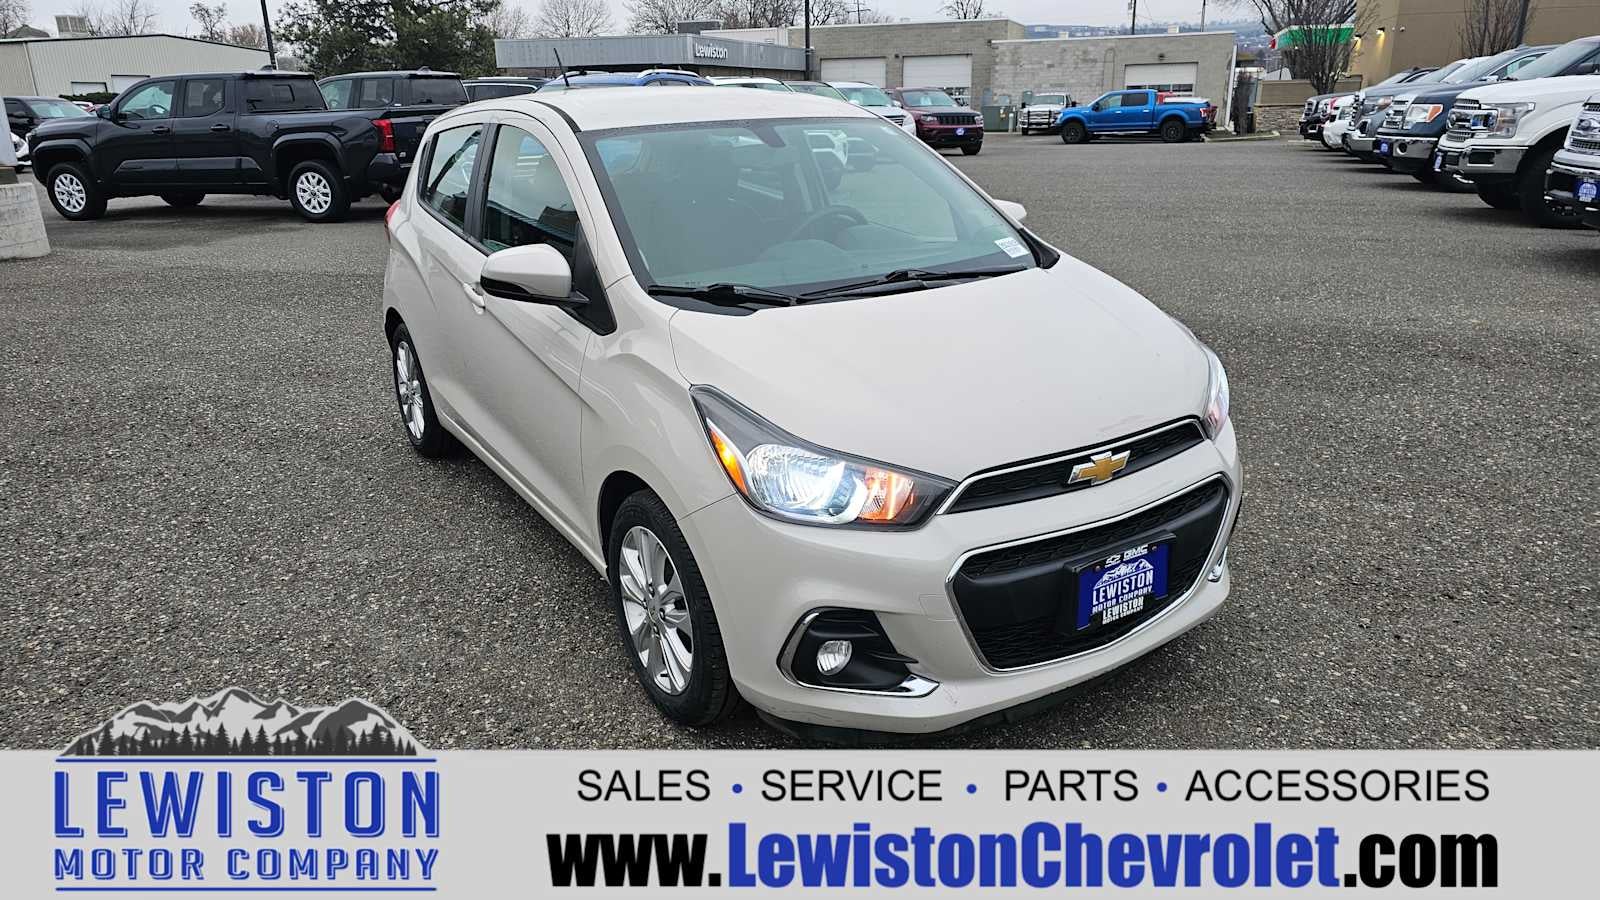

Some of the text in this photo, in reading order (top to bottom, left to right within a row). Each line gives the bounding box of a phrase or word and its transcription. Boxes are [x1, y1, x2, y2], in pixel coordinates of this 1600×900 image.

[695, 42, 728, 59] Lewiston
[1123, 544, 1149, 561] GMC
[1093, 570, 1154, 606] LEWISTON
[1092, 585, 1153, 615] MOTOR COMPANY
[1103, 596, 1144, 619] LEWISTON
